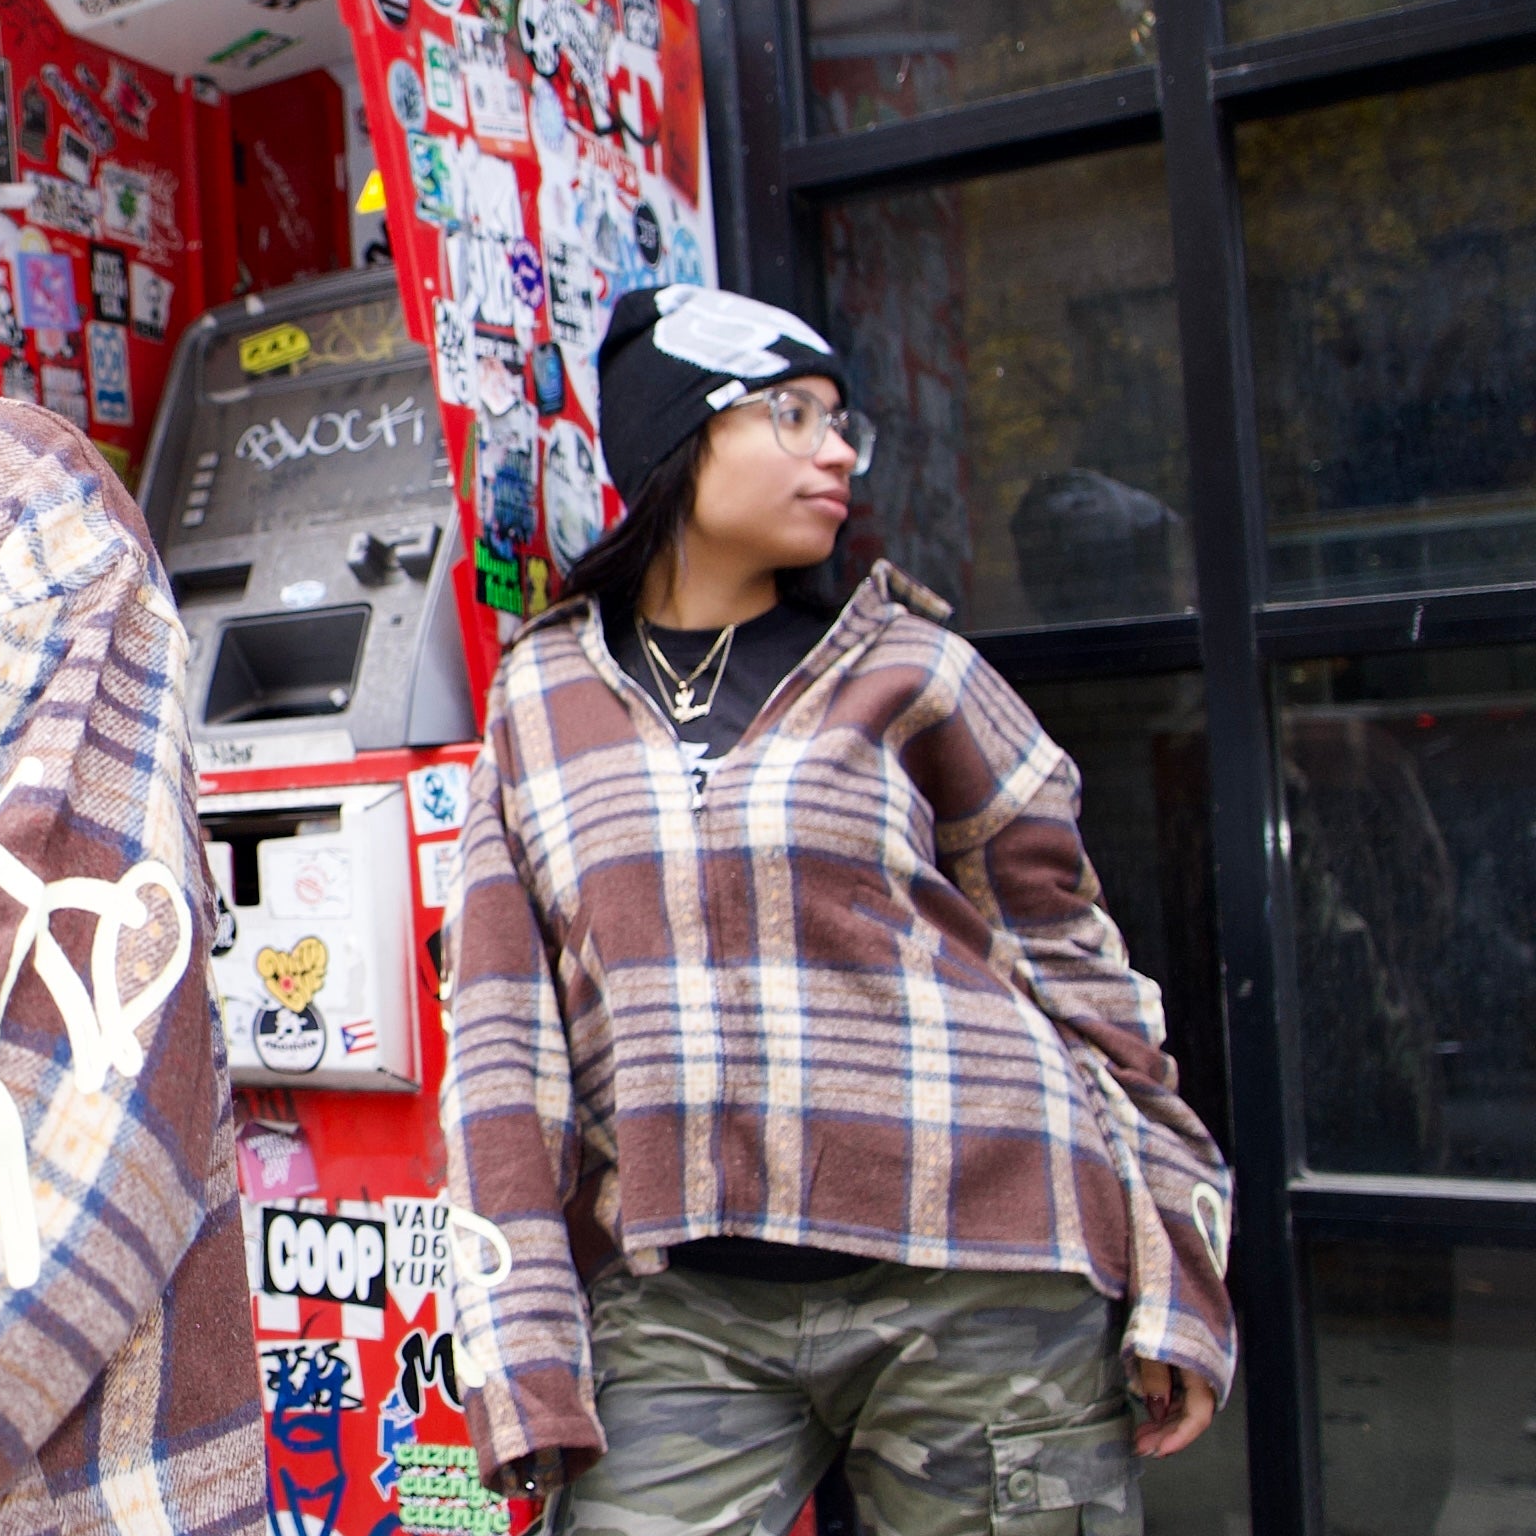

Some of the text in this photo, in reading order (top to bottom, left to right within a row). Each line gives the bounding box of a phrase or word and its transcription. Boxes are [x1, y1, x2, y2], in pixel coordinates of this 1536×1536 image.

[267, 1214, 385, 1302] COOP
[412, 1234, 447, 1259] D6
[392, 1261, 446, 1289] YUK
